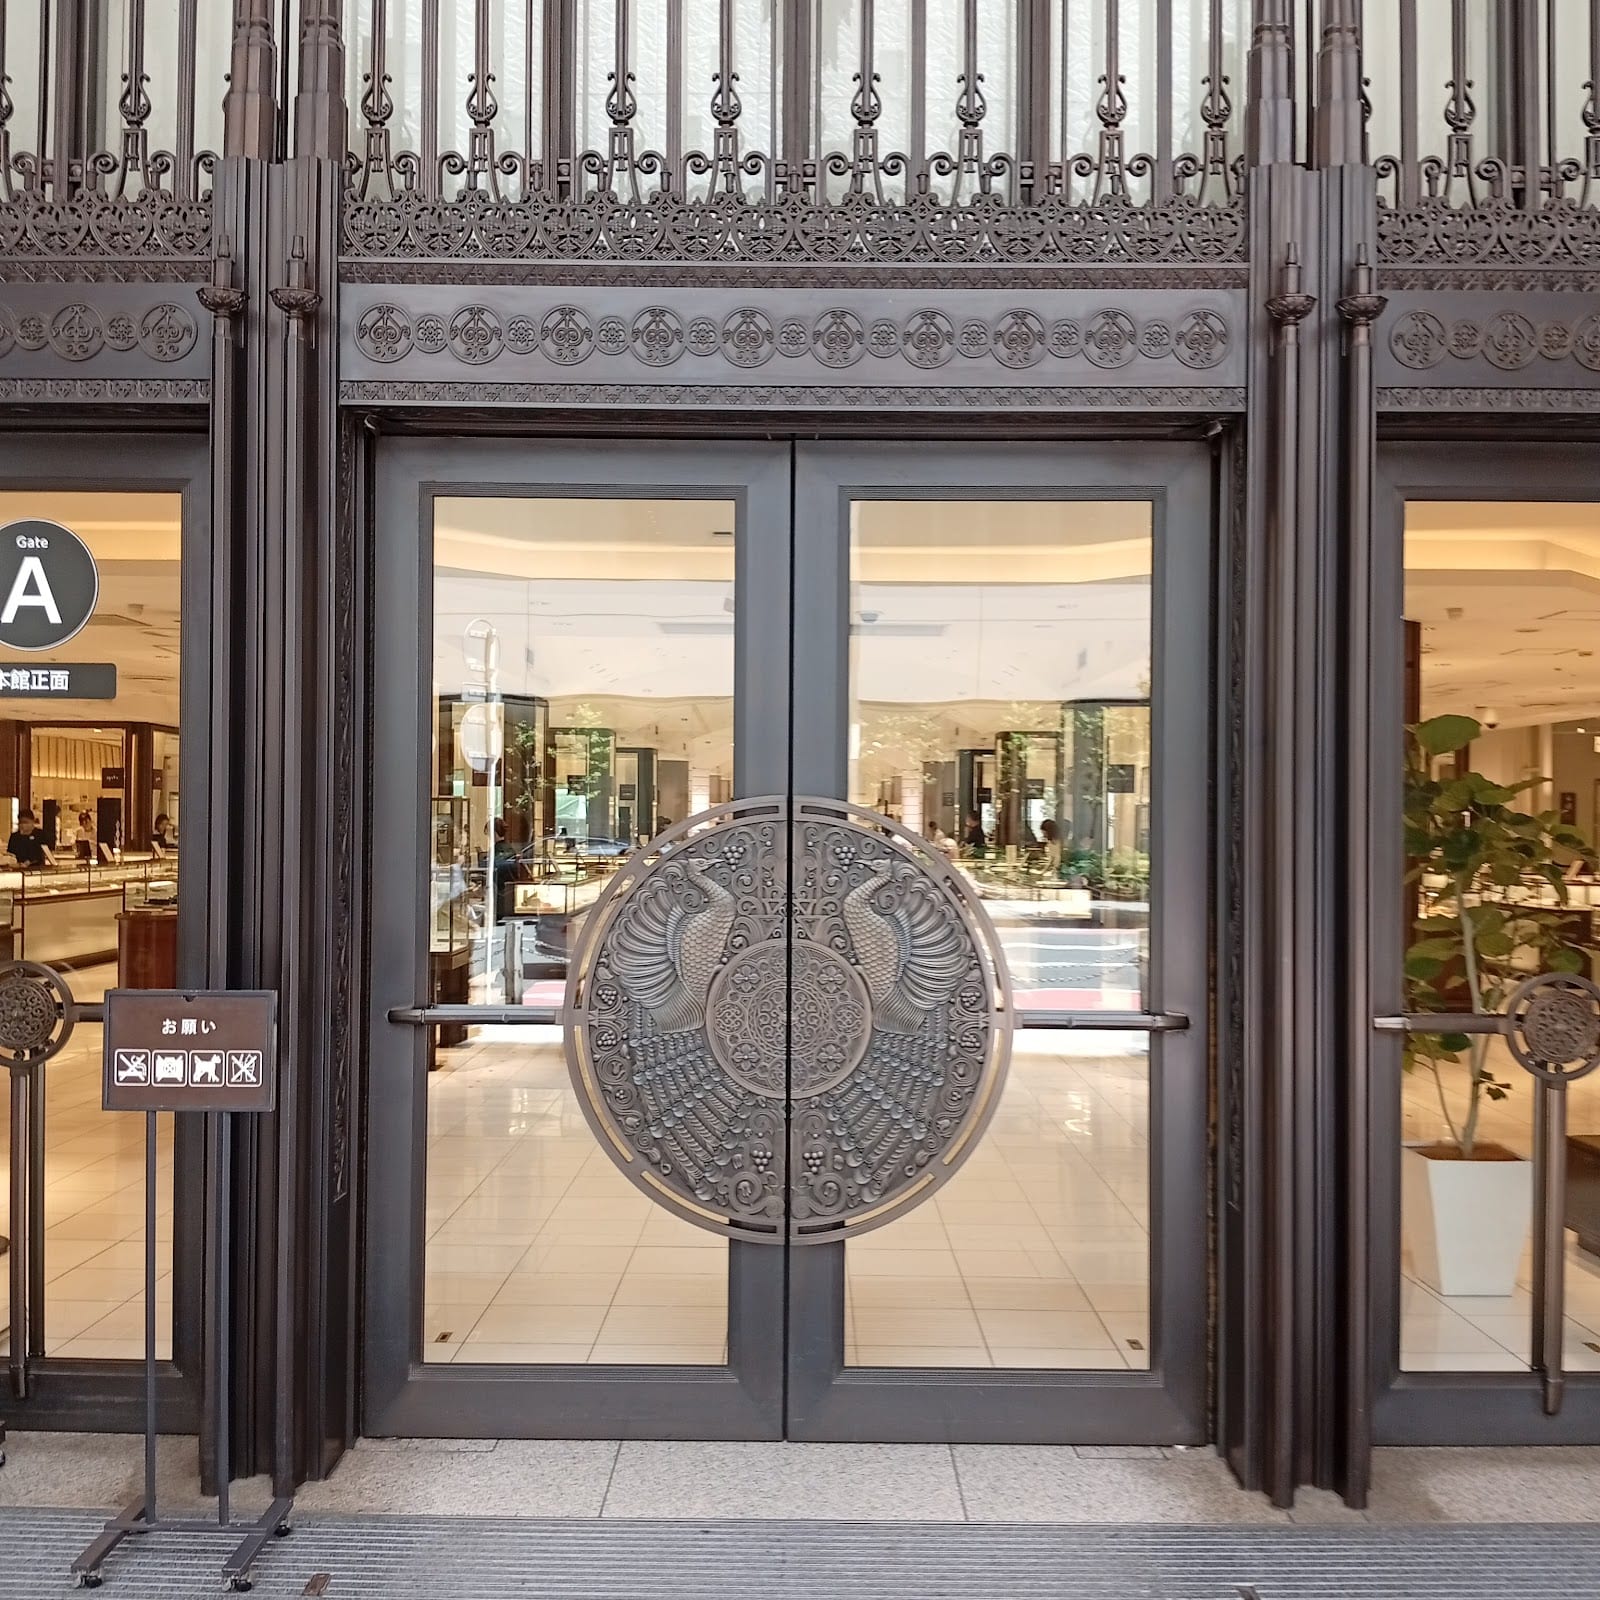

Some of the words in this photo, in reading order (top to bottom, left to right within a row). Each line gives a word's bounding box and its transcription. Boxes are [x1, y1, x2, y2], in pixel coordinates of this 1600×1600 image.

[15, 535, 49, 549] Gate
[0, 556, 63, 624] A
[162, 1018, 217, 1036] お願い
